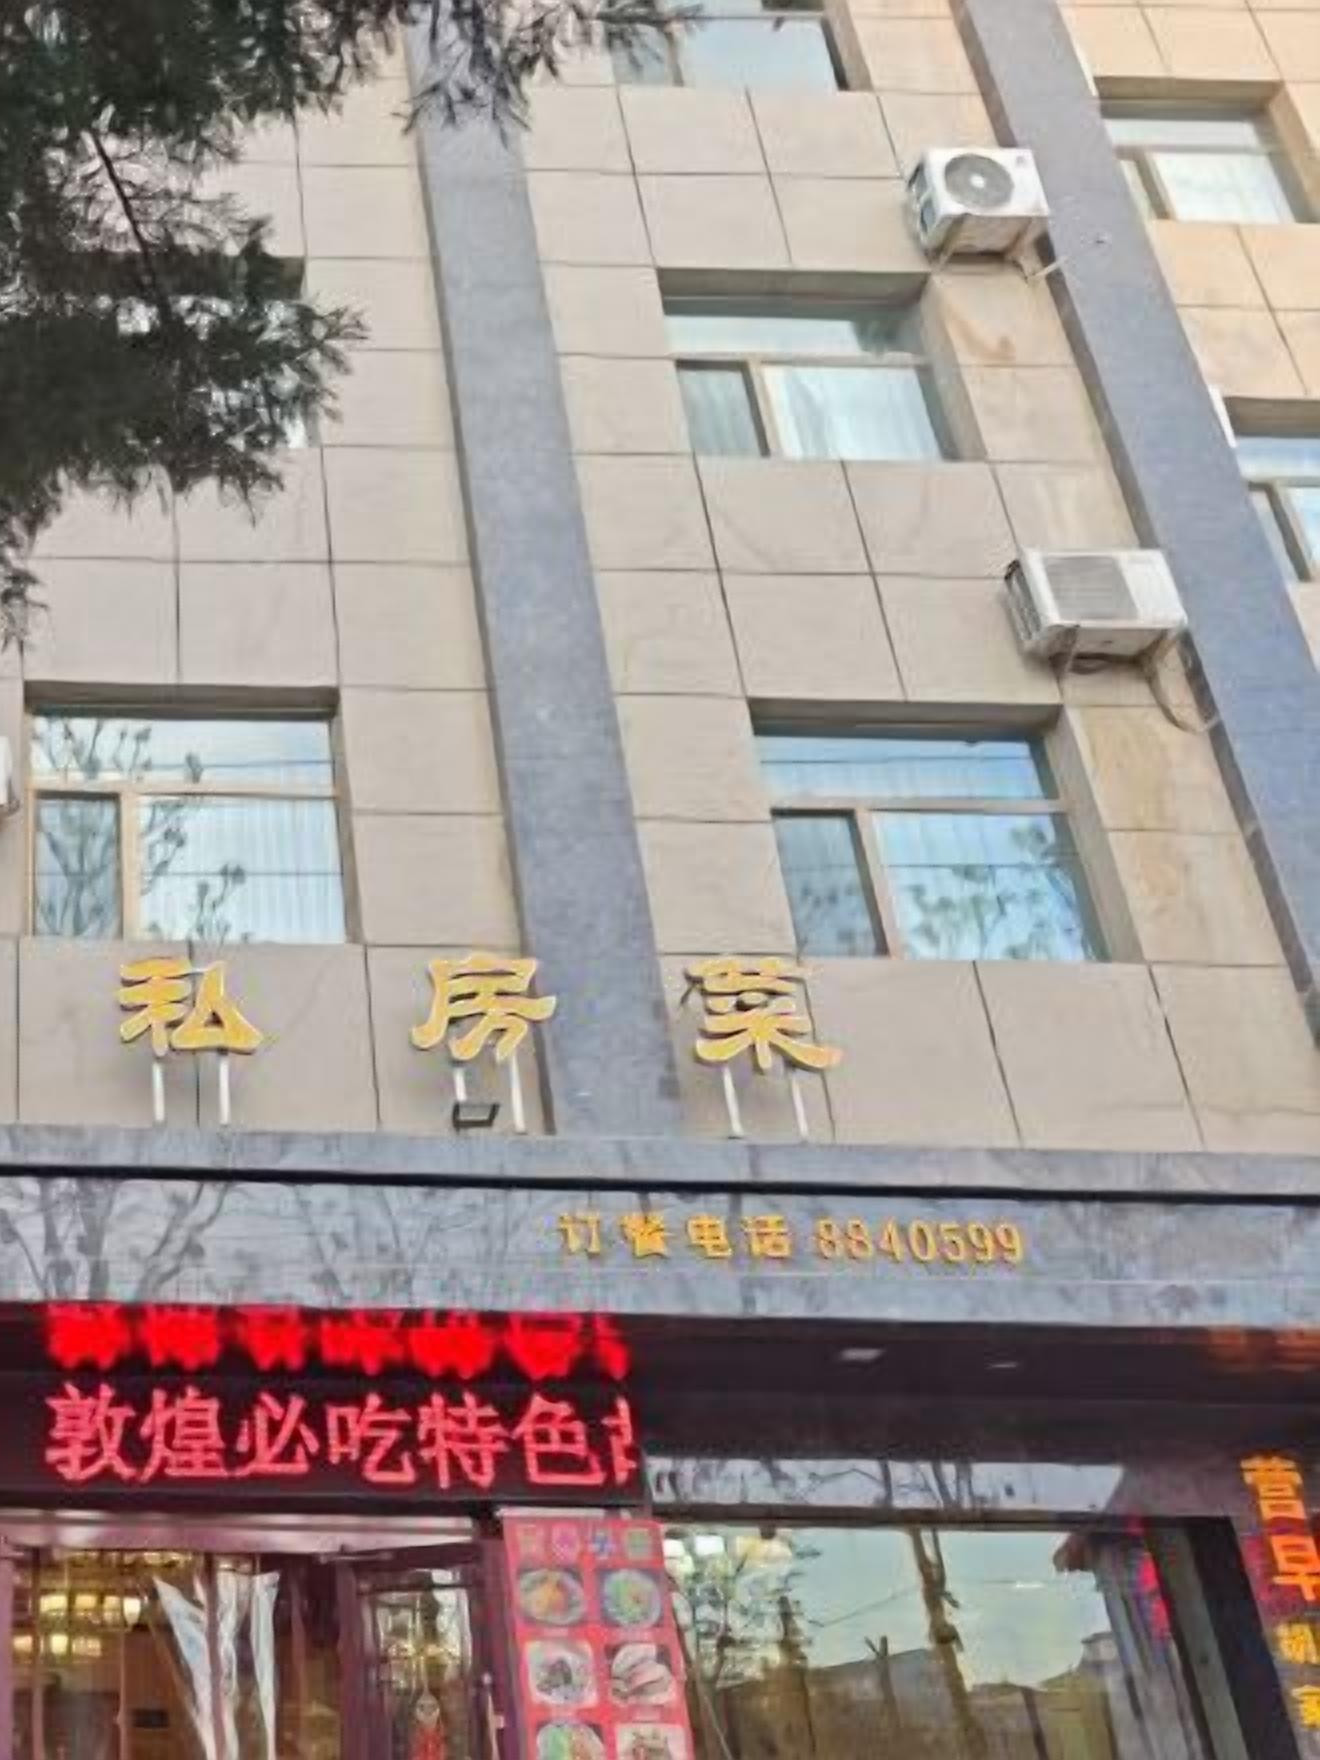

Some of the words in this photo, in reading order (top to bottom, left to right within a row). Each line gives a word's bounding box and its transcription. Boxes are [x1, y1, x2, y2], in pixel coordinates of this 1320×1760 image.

[118, 953, 843, 1071] 私房菜
[558, 1212, 792, 1259] 订餐电话
